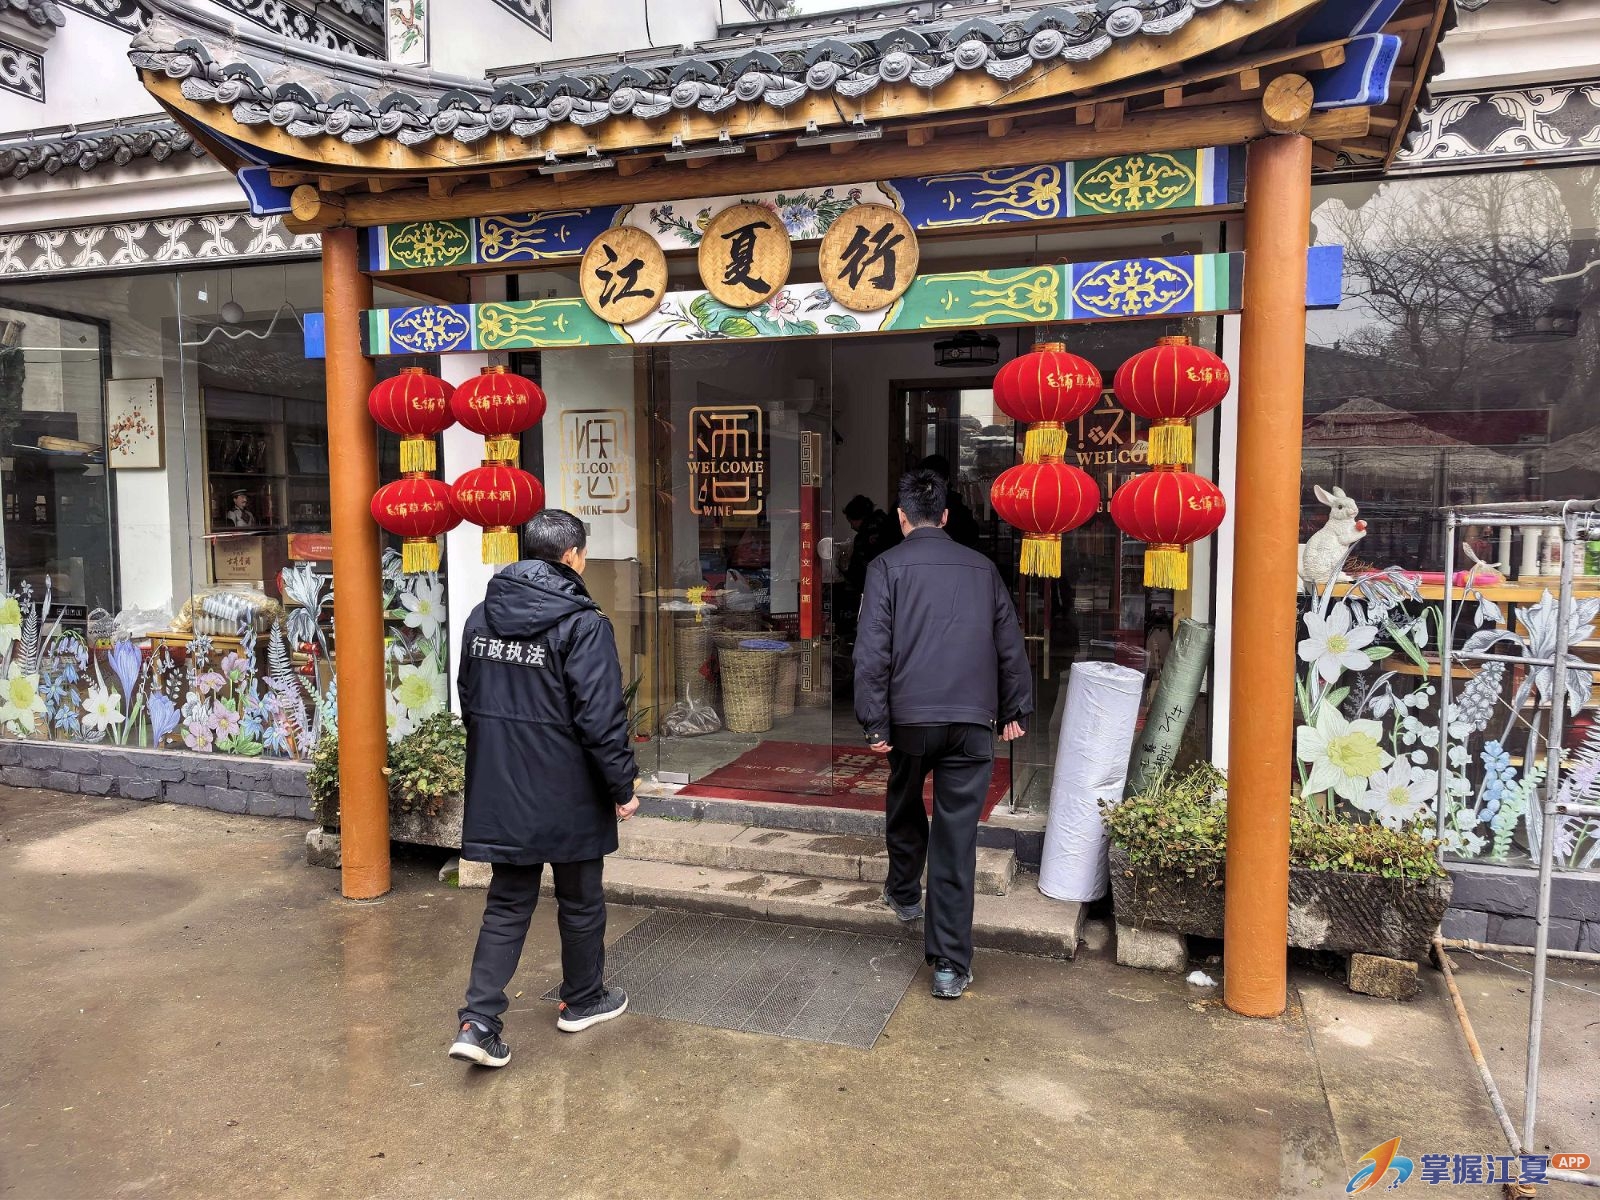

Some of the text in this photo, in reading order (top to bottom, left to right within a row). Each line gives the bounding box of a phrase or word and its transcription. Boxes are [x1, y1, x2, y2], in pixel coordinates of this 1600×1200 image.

[595, 221, 905, 309] 江夏行
[1076, 450, 1148, 465] WELCO
[560, 462, 625, 474] WELCOME
[687, 460, 764, 474] WELCOME
[703, 505, 732, 517] WINE
[472, 635, 546, 666] 行政执法
